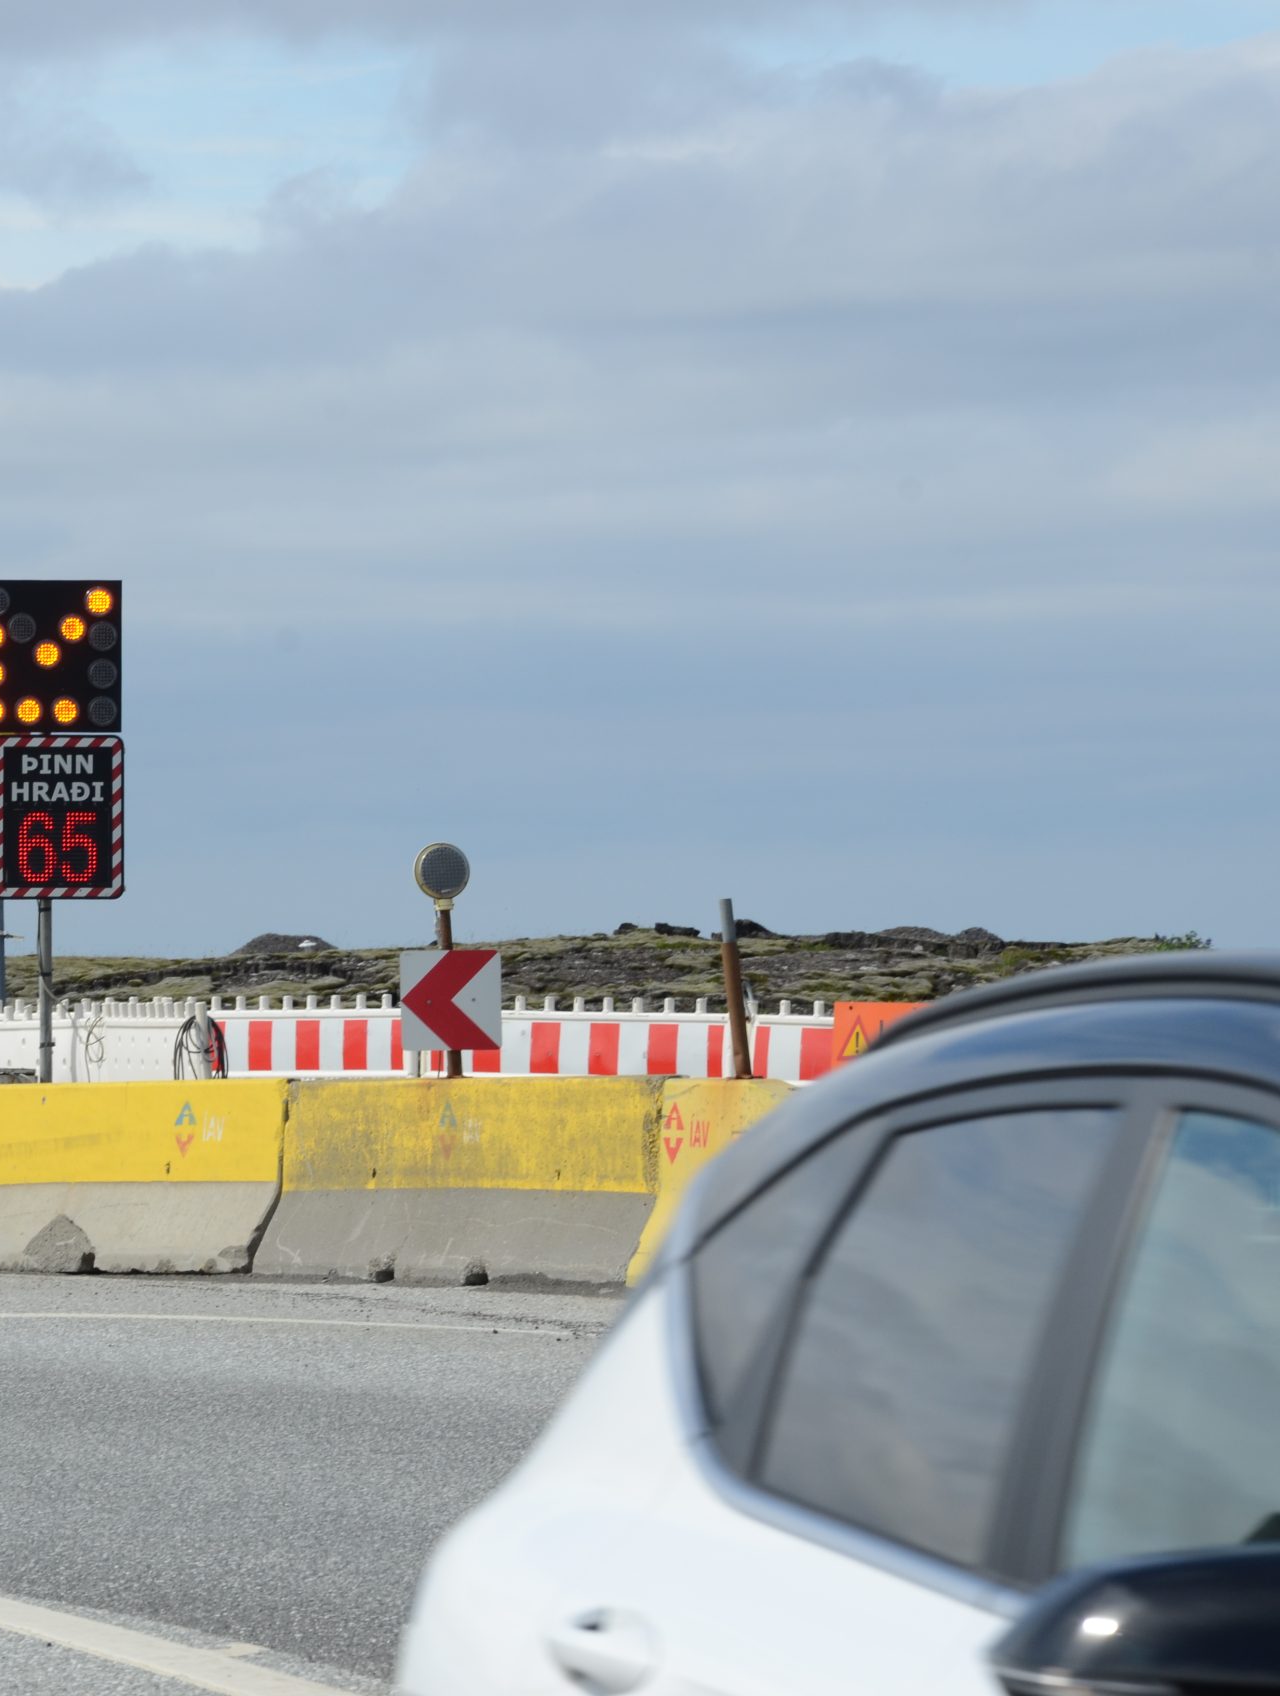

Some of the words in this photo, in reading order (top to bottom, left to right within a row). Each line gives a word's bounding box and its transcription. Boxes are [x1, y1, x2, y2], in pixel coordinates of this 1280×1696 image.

[21, 754, 94, 775] ÞINN
[11, 781, 105, 803] HRAÐI
[18, 811, 99, 883] 65
